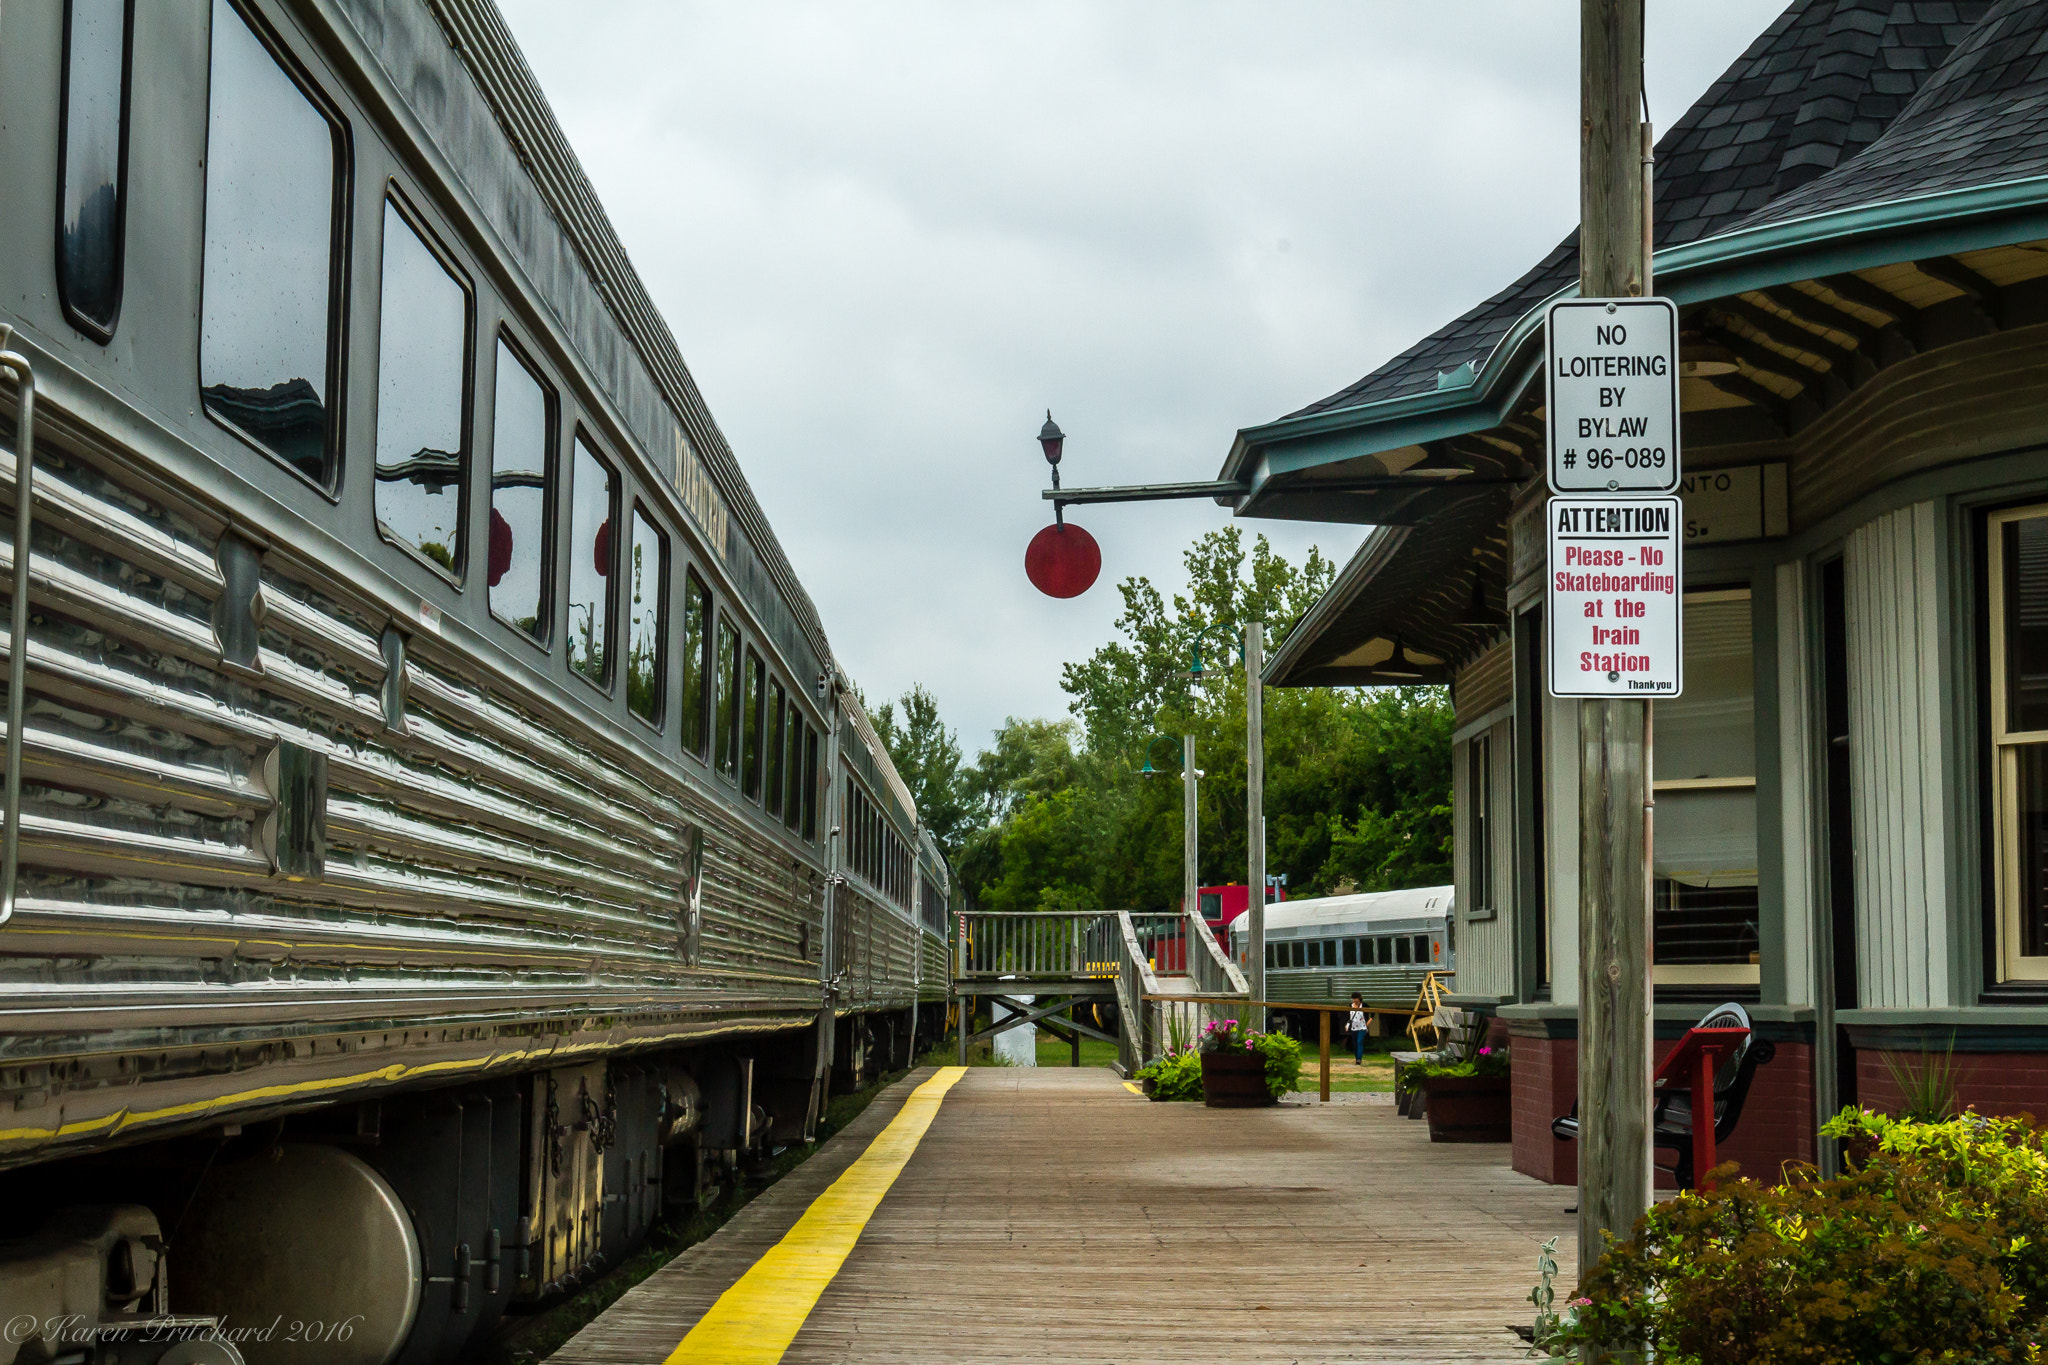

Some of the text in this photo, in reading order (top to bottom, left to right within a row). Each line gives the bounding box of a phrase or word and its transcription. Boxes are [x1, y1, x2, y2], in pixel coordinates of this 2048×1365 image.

[1597, 325, 1627, 345] NO
[1559, 355, 1666, 377] LOITERING
[1599, 387, 1626, 408] BY
[1578, 417, 1648, 438] BYLAW
[1563, 448, 1666, 469] # 96-089
[1680, 473, 1731, 494] NTO
[1558, 507, 1670, 533] ATTENTION
[1686, 521, 1708, 538] S.
[1565, 546, 1624, 567] Please
[1640, 546, 1664, 567] No
[1555, 571, 1674, 595] Skateboarding
[1583, 598, 1646, 618] at the
[1580, 651, 1650, 672] Station
[1627, 679, 1672, 691] Thank you
